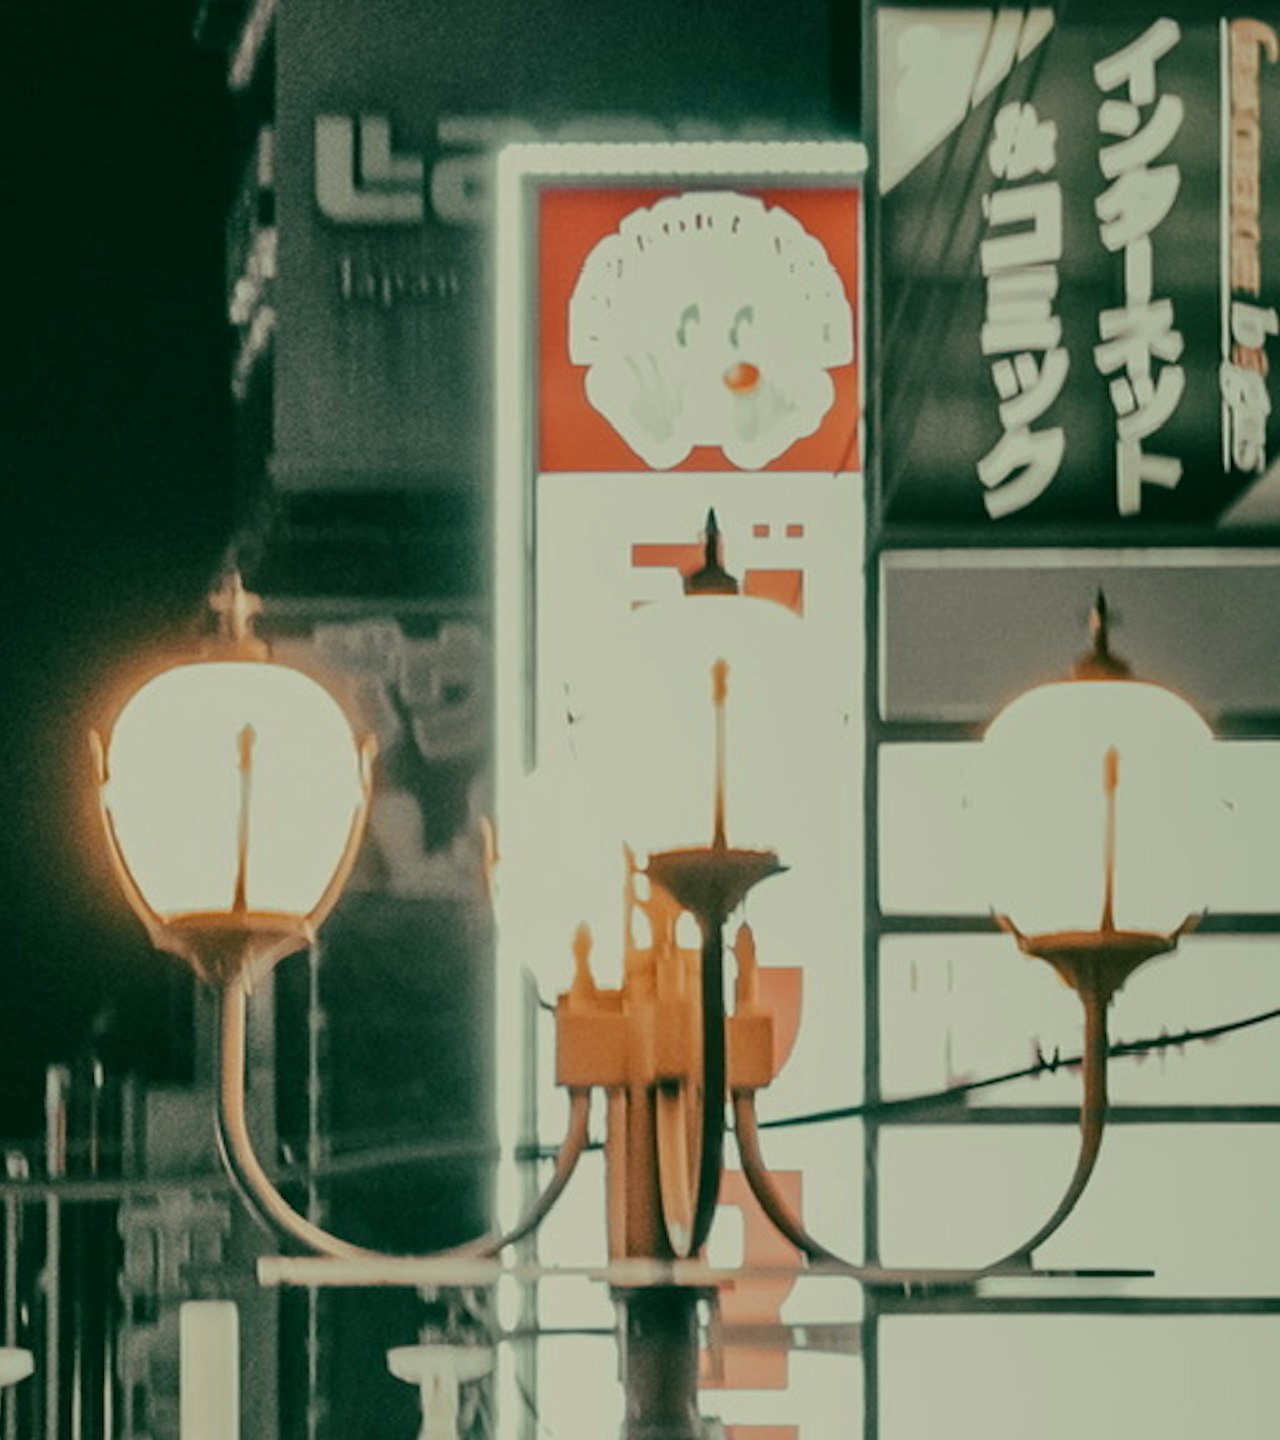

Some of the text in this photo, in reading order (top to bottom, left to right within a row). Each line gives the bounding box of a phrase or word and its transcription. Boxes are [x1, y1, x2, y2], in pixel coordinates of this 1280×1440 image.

[1092, 18, 1186, 516] インターネット
